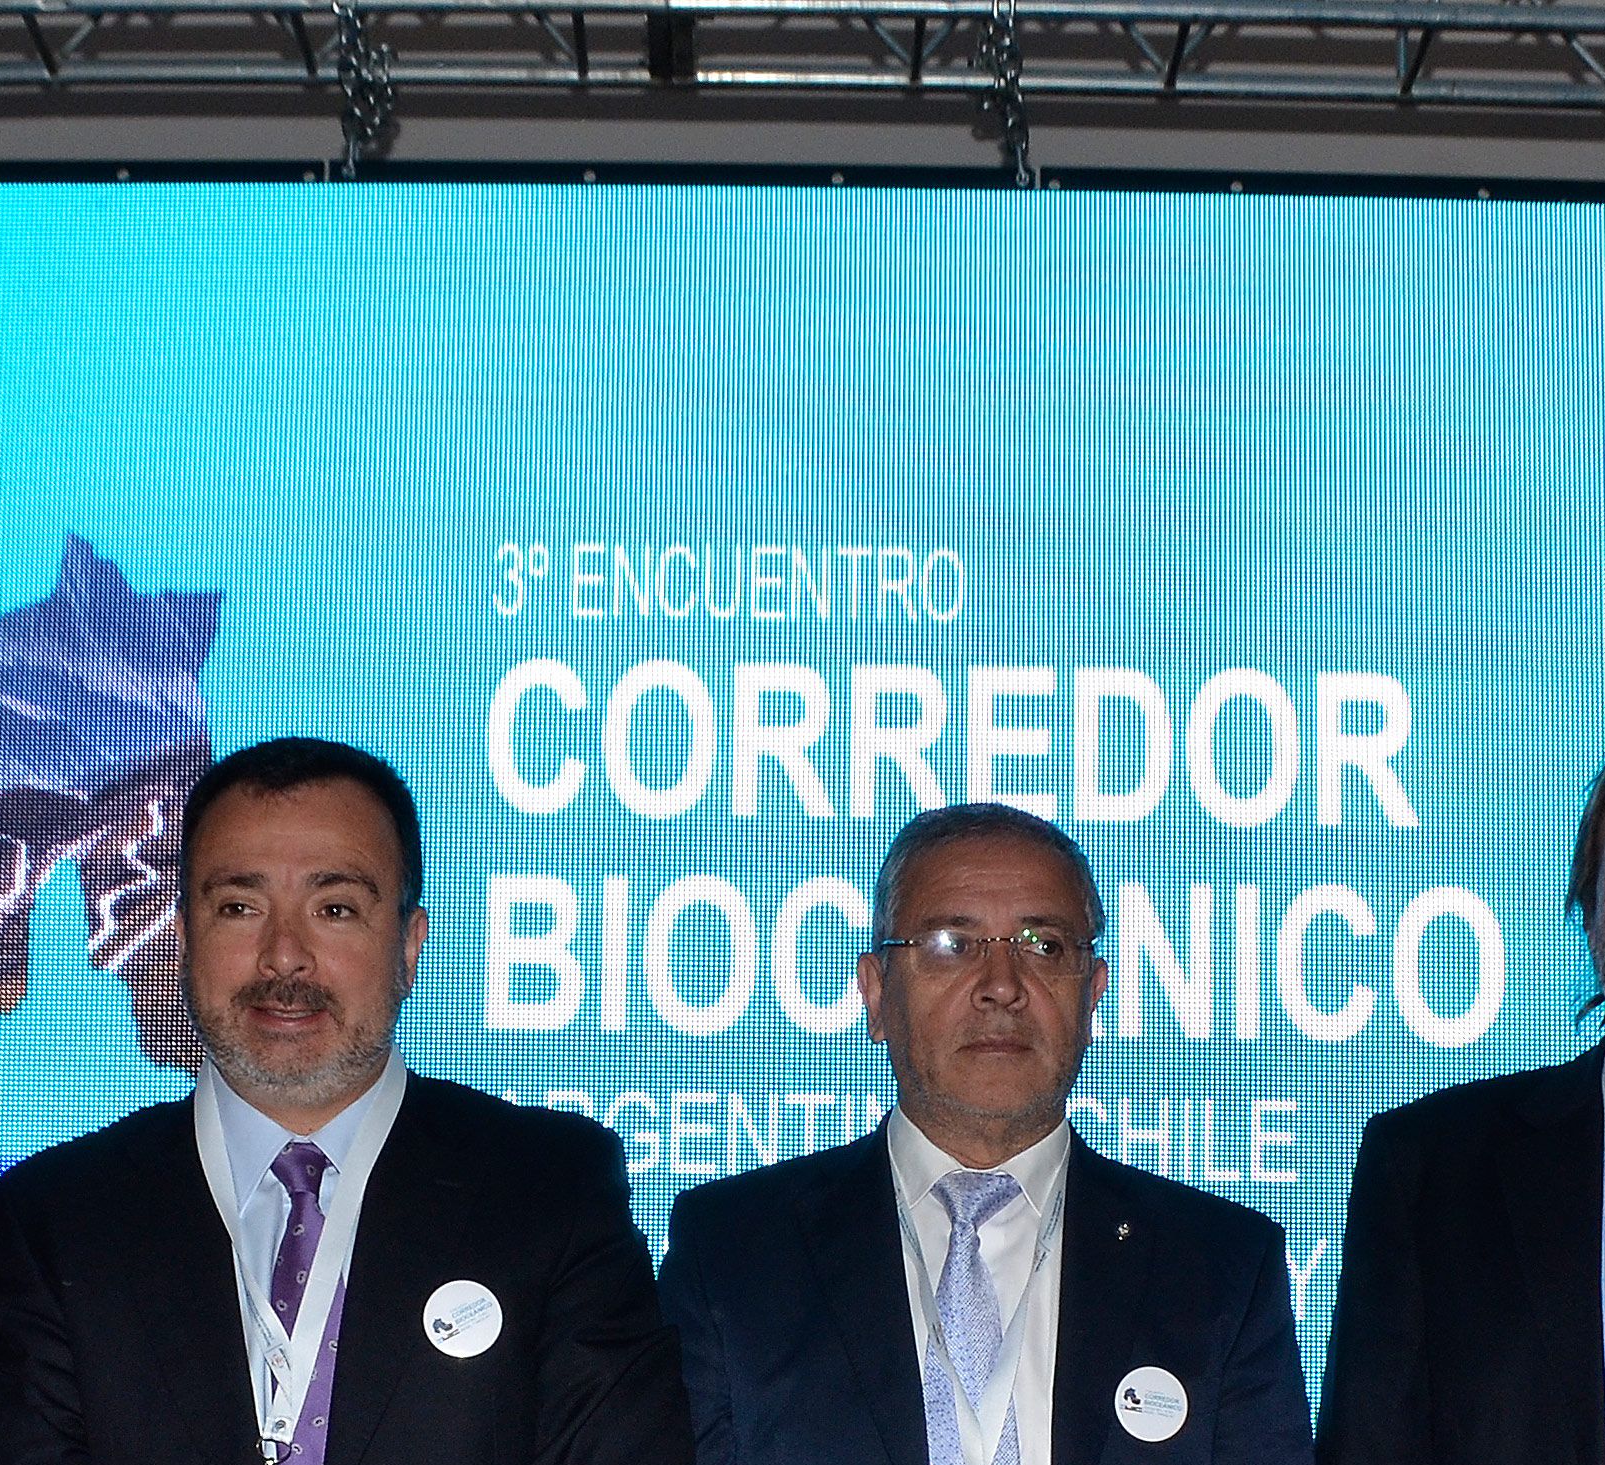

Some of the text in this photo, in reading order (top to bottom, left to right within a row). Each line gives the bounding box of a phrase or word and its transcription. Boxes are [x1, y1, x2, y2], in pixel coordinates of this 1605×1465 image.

[572, 542, 965, 622] ENCUENTRO
[487, 657, 1419, 829] CORREDOR
[482, 872, 1507, 1048] BIOCNICO
